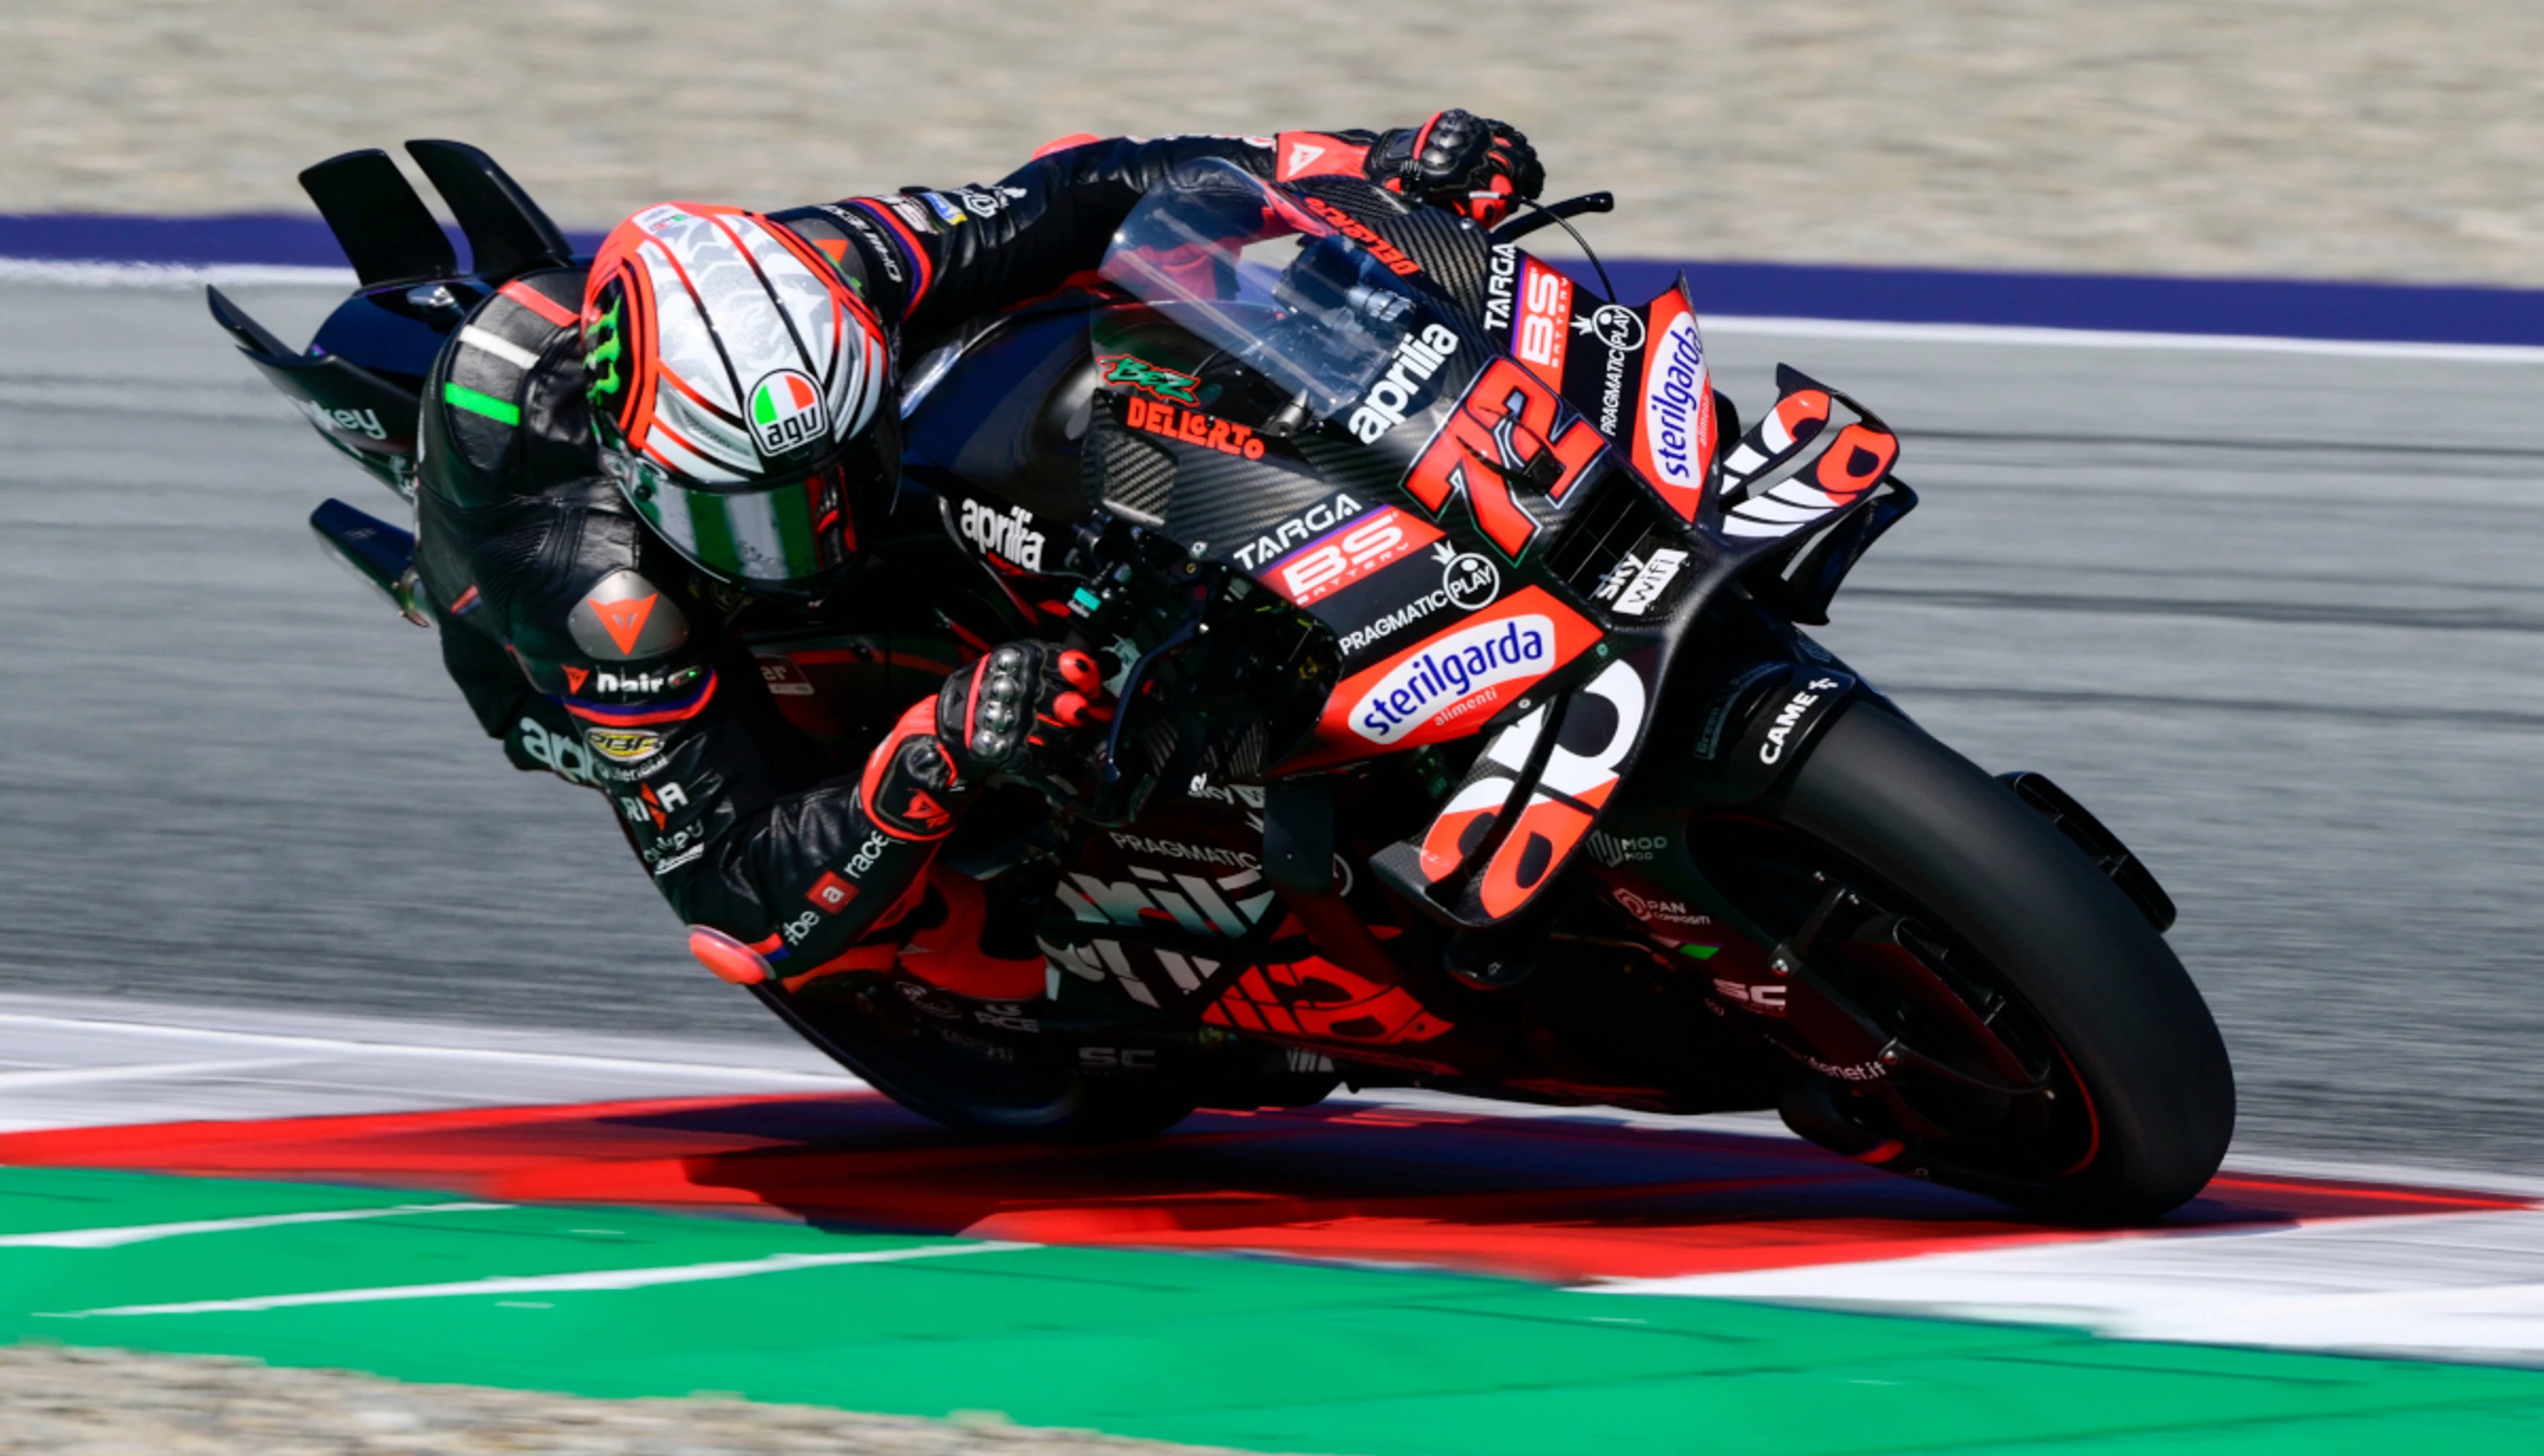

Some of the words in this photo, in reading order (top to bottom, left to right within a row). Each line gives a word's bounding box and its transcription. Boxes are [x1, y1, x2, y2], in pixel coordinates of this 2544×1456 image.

[1484, 242, 1516, 331] TARGA
[1521, 267, 1560, 366] BS
[1551, 277, 1569, 368] BATTERY
[1610, 308, 1630, 352] PLAY
[1348, 323, 1459, 445] aprilia
[1599, 350, 1626, 437] PRAGMATIC
[1651, 326, 1703, 478] sterilgarda
[767, 407, 816, 445] agv
[1398, 355, 1612, 568] 72
[960, 497, 1045, 572] aprilia
[1233, 494, 1362, 570] TARGA
[1283, 512, 1402, 597] BS
[1296, 543, 1408, 604] BATTERY
[1338, 590, 1448, 655] PRAGMATIC
[1450, 566, 1493, 599] PLAY
[1364, 622, 1543, 735] sterilgarda
[1435, 687, 1497, 727] alimenti
[1758, 690, 1819, 765] CAME
[1109, 831, 1262, 871] PRAGMATIC
[822, 886, 845, 904] a
[1646, 900, 1687, 915] PAN
[1078, 1046, 1156, 1069] SC
